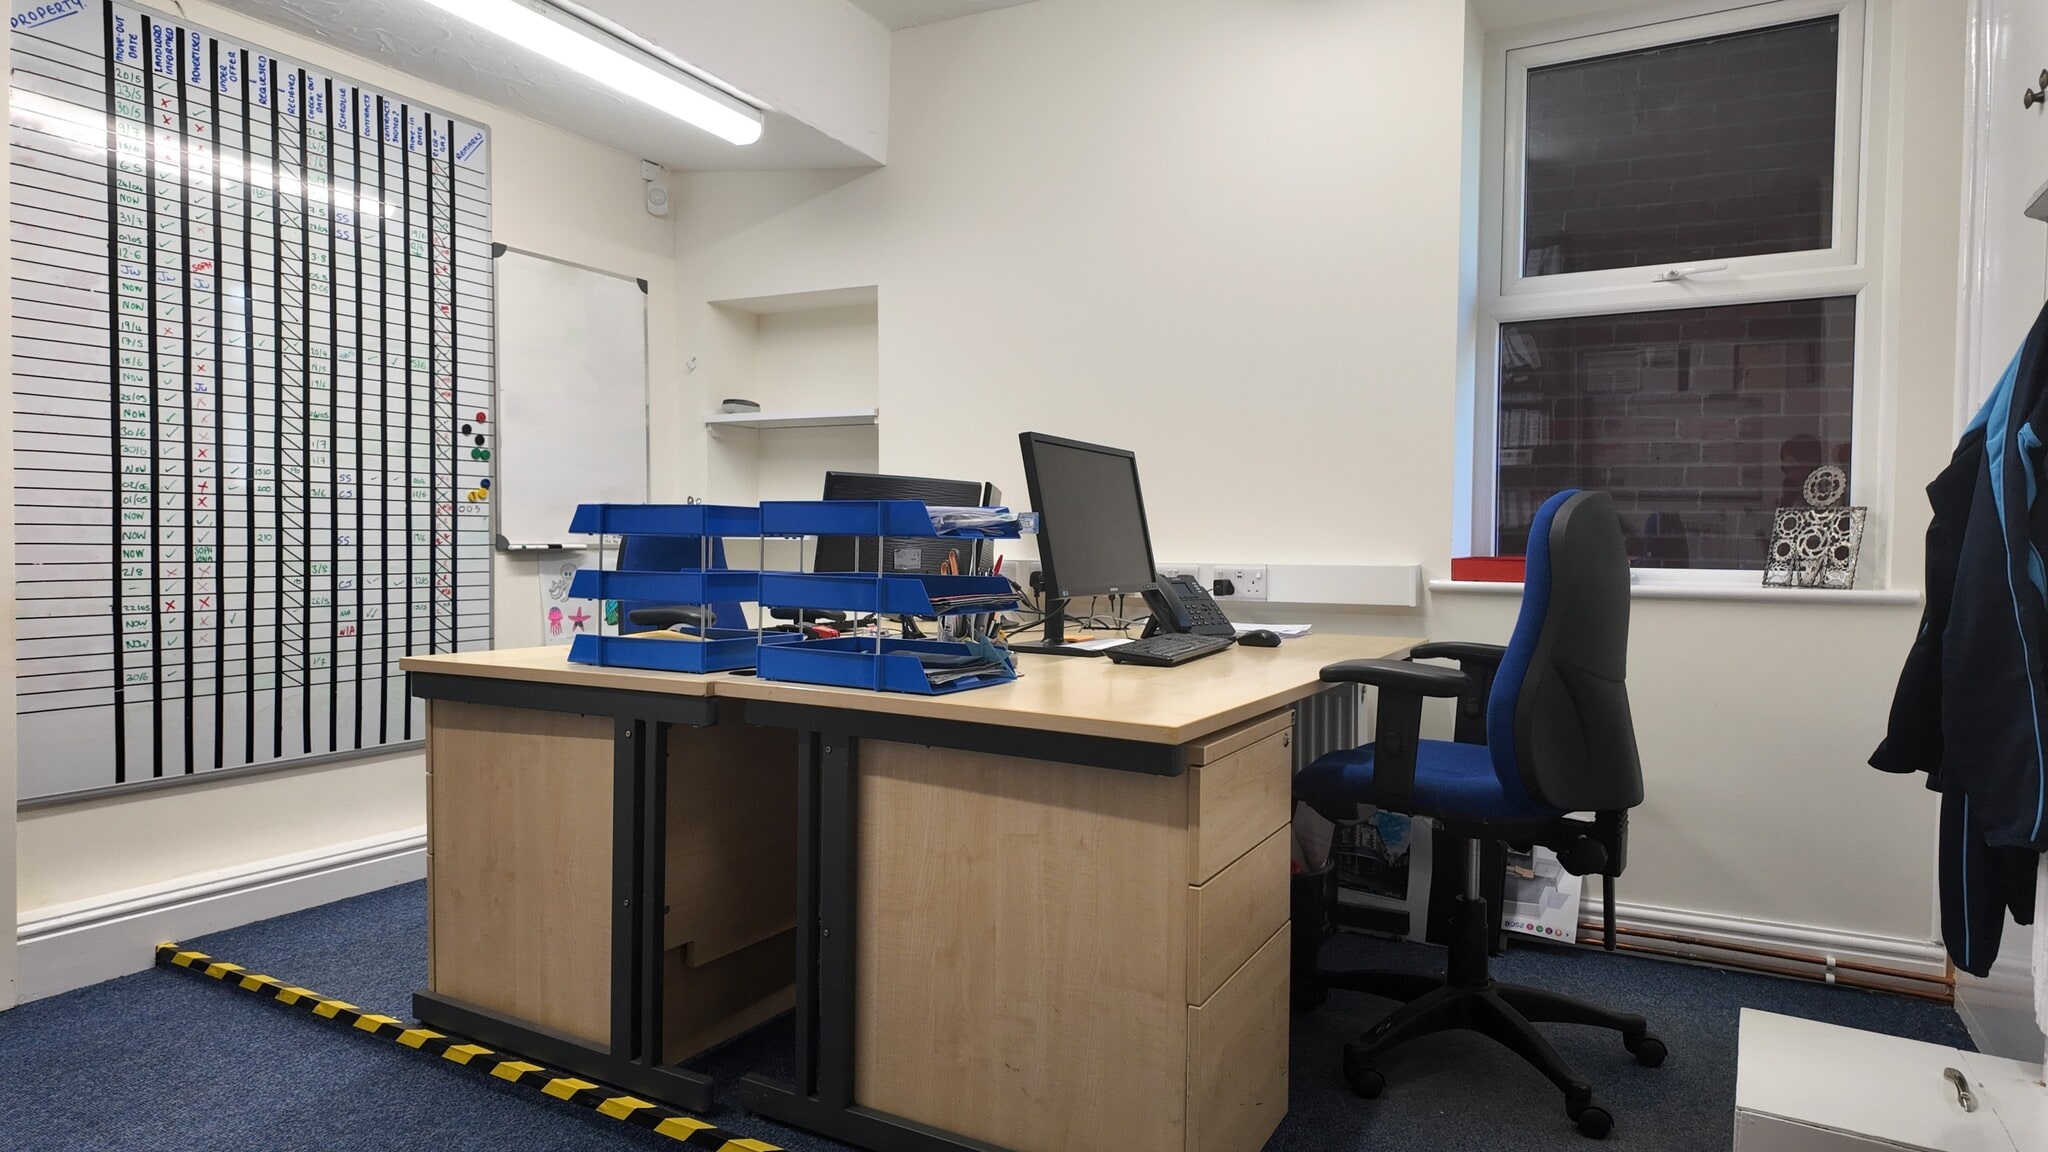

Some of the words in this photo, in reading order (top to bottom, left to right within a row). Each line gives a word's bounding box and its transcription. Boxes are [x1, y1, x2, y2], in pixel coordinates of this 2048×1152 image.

[128, 33, 138, 59] DATE
[153, 25, 163, 72] LANDLORD
[165, 28, 174, 75] INFORMED
[191, 32, 201, 83] ADVERTISED
[228, 51, 237, 82] OFFER
[116, 68, 142, 83] 20/5
[220, 65, 228, 92] UNDER
[258, 56, 267, 105] REQUESTED
[116, 83, 141, 100] 23/5
[116, 100, 141, 118] 30/5
[338, 88, 347, 129] SCHEDULE
[455, 132, 483, 160] REMARKS
[119, 193, 140, 204] NOW
[119, 212, 143, 226] 31/7
[122, 283, 143, 292] NOW
[122, 300, 144, 311] NOW
[123, 373, 143, 382] NOW
[123, 409, 146, 418] NOW
[125, 465, 146, 473] NOW
[124, 512, 144, 520] NOW
[122, 530, 147, 540] NOW
[123, 549, 144, 558] NOW
[122, 567, 143, 577] 2/8
[125, 620, 147, 628] NOW
[125, 640, 149, 648] NOW
